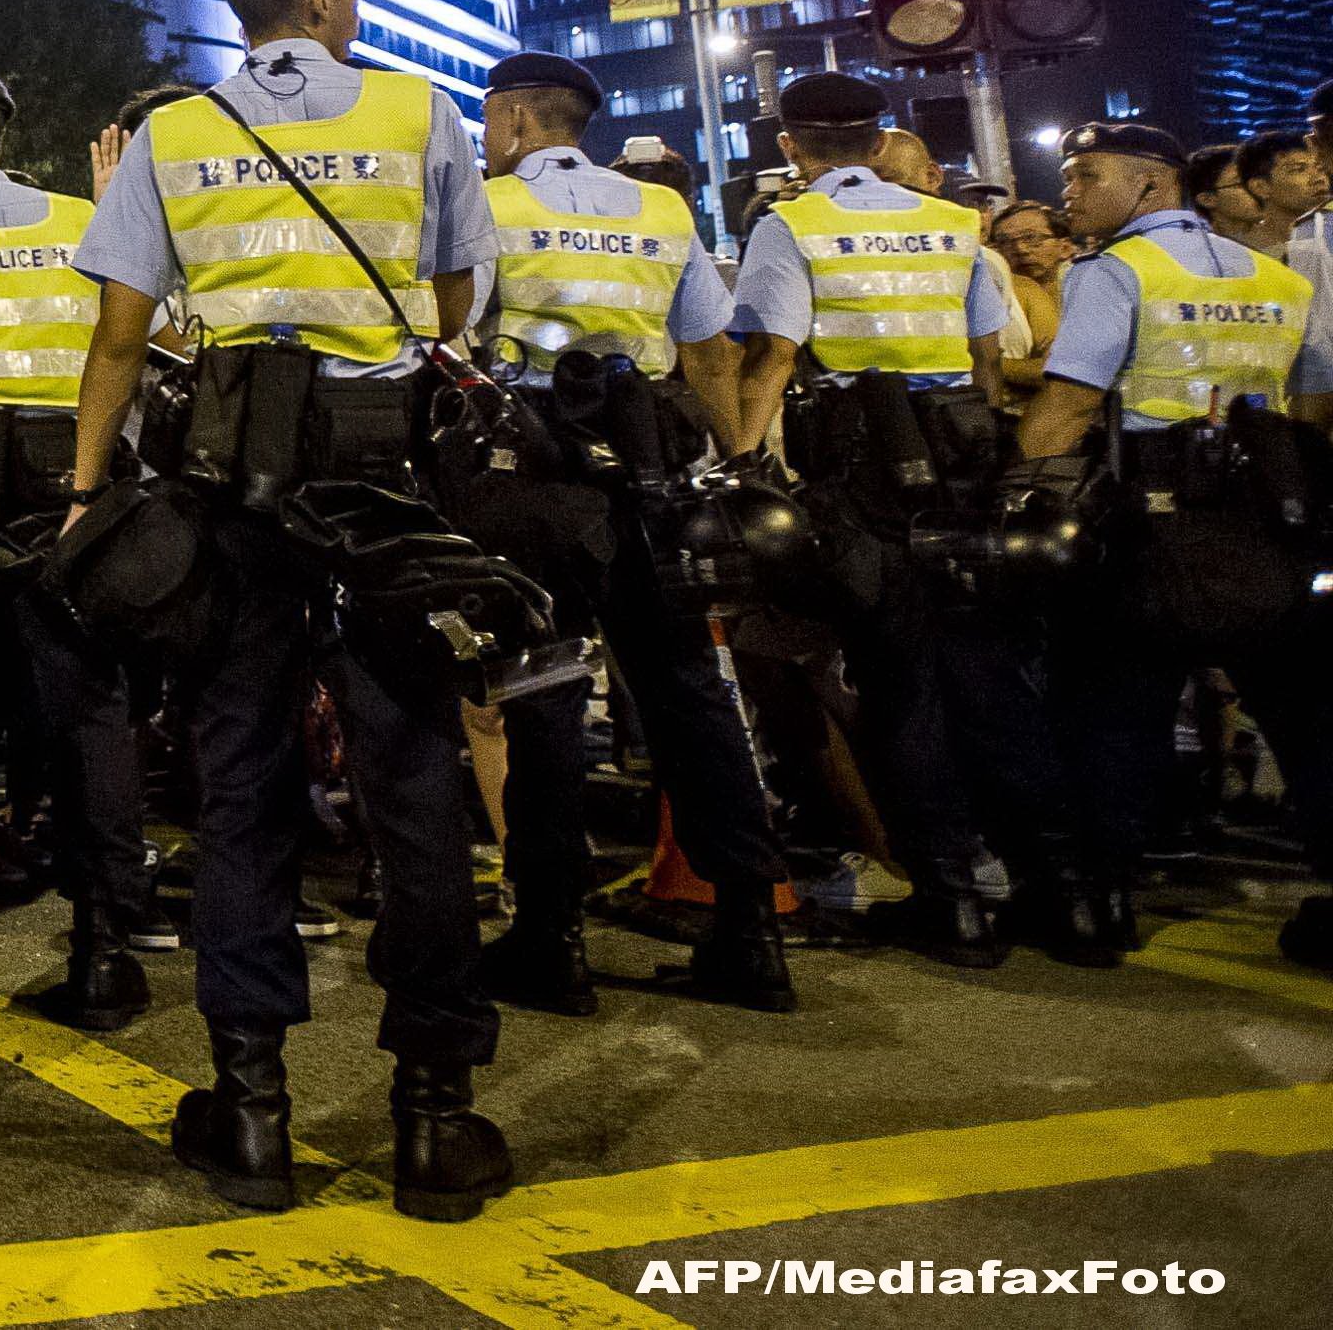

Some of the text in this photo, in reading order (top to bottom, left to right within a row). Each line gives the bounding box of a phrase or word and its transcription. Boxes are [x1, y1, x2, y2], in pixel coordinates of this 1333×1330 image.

[558, 230, 634, 255] POLICE
[862, 234, 934, 254] POLICE
[1201, 303, 1269, 324] POLICE
